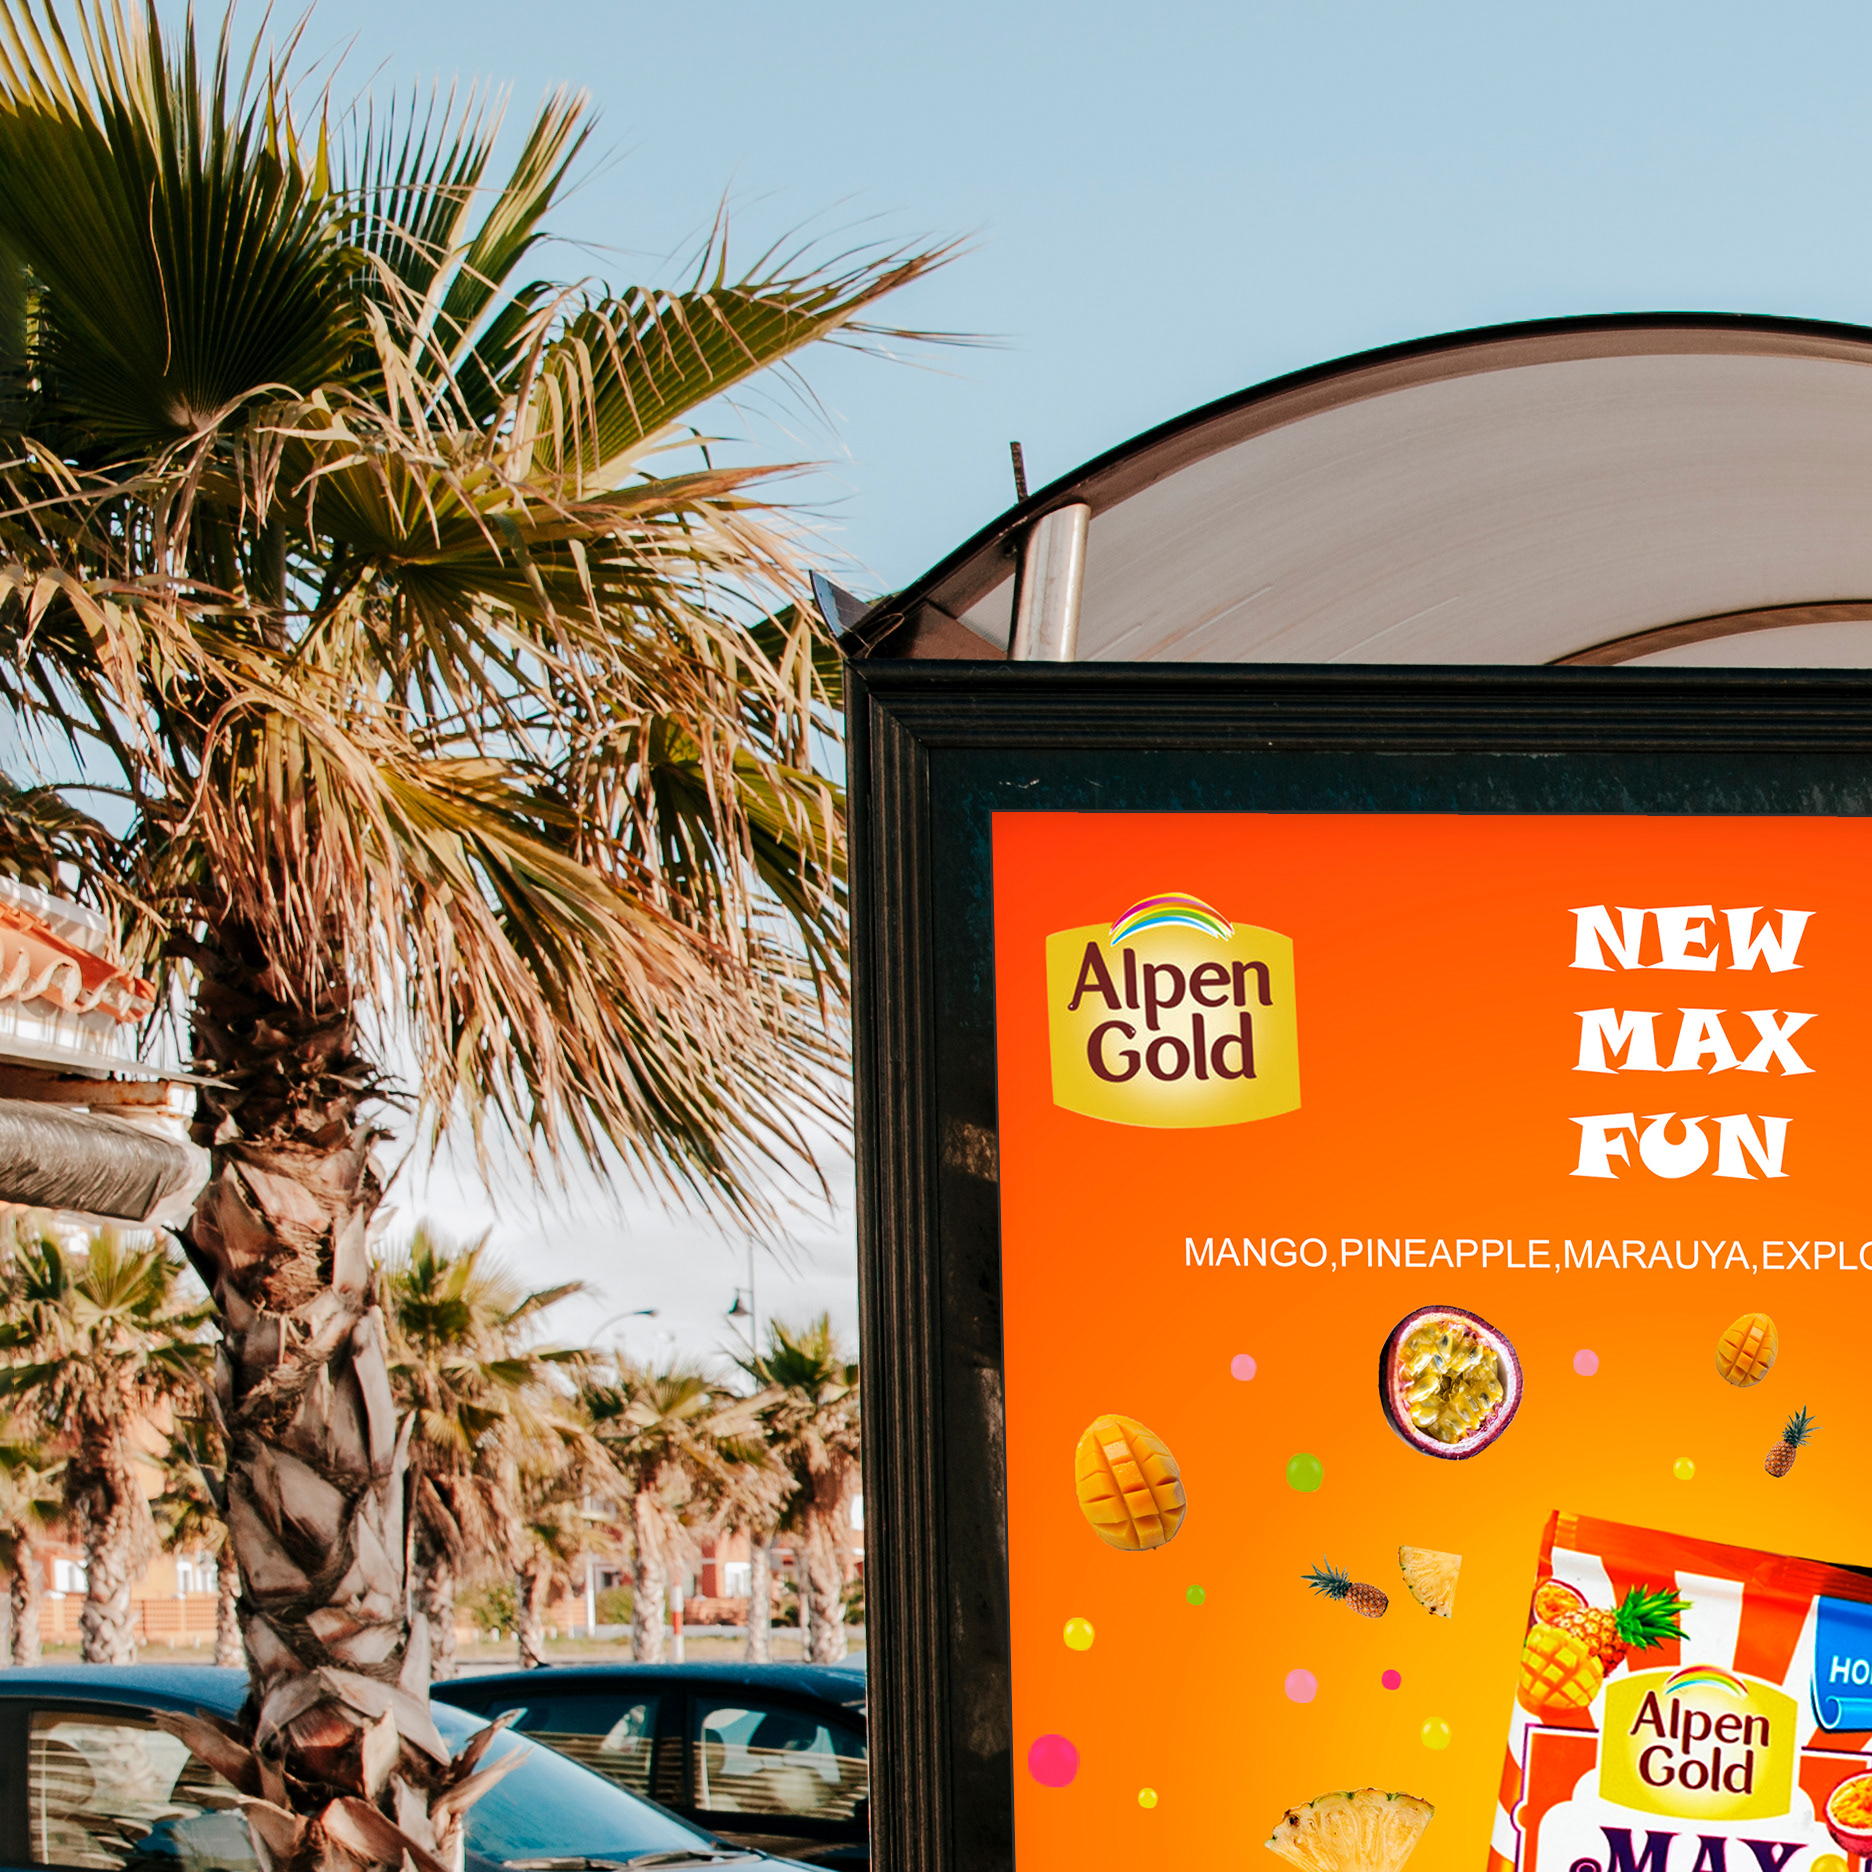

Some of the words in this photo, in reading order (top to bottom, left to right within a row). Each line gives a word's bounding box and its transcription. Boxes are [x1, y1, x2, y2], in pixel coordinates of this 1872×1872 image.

[1568, 905, 1817, 973] NEW
[1067, 941, 1273, 1031] Alpen
[1087, 1011, 1257, 1083] Gold
[1571, 1007, 1818, 1077] MAX
[1568, 1111, 1794, 1181] FUN
[1630, 1690, 1769, 1755] Alpen
[1638, 1744, 1754, 1795] Gold
